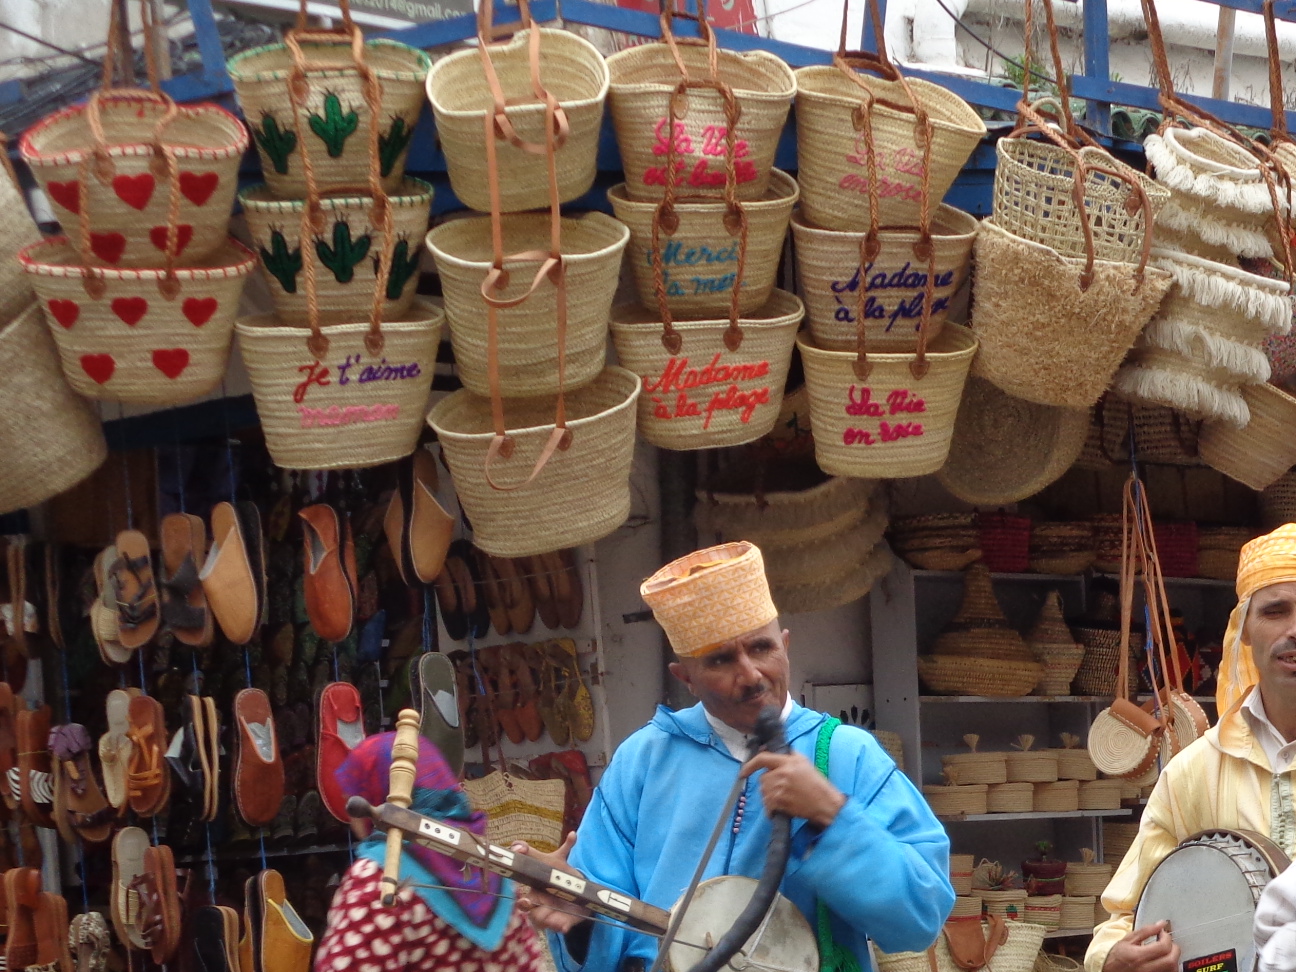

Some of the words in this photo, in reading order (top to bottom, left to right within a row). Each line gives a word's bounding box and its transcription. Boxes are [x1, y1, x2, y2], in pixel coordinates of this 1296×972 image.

[701, 124, 750, 158] Ve
[831, 261, 953, 292] Madame
[642, 352, 770, 393] Madame
[651, 396, 673, 419] à
[674, 391, 702, 418] la
[702, 384, 770, 430] plage
[1188, 951, 1233, 969] BOILERS
